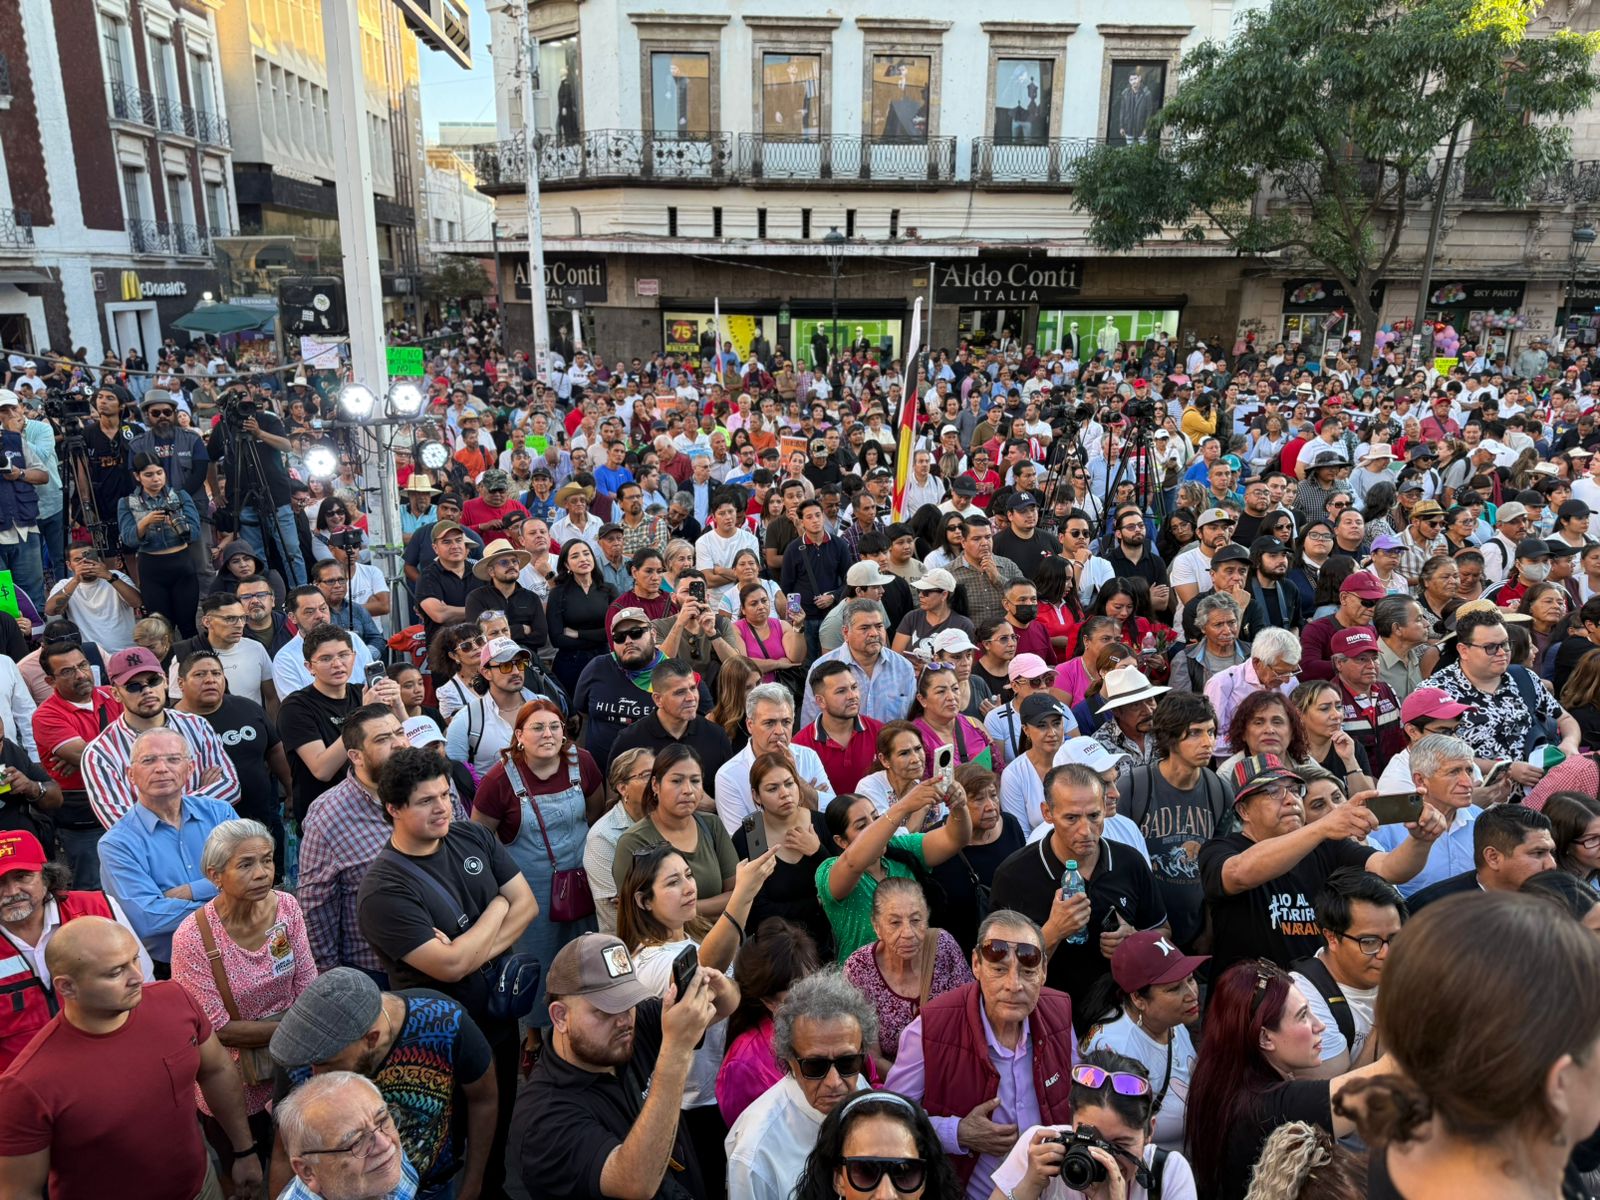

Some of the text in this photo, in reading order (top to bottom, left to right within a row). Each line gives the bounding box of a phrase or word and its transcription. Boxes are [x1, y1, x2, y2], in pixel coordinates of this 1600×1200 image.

[514, 262, 601, 286] Alo Conti
[940, 263, 1077, 287] Aldo Conti
[974, 290, 1038, 301] ITALIA
[673, 325, 692, 340] 75
[1346, 633, 1372, 642] morena
[596, 701, 656, 716] HILFIGE
[221, 725, 257, 746] GO
[406, 723, 433, 738] morena
